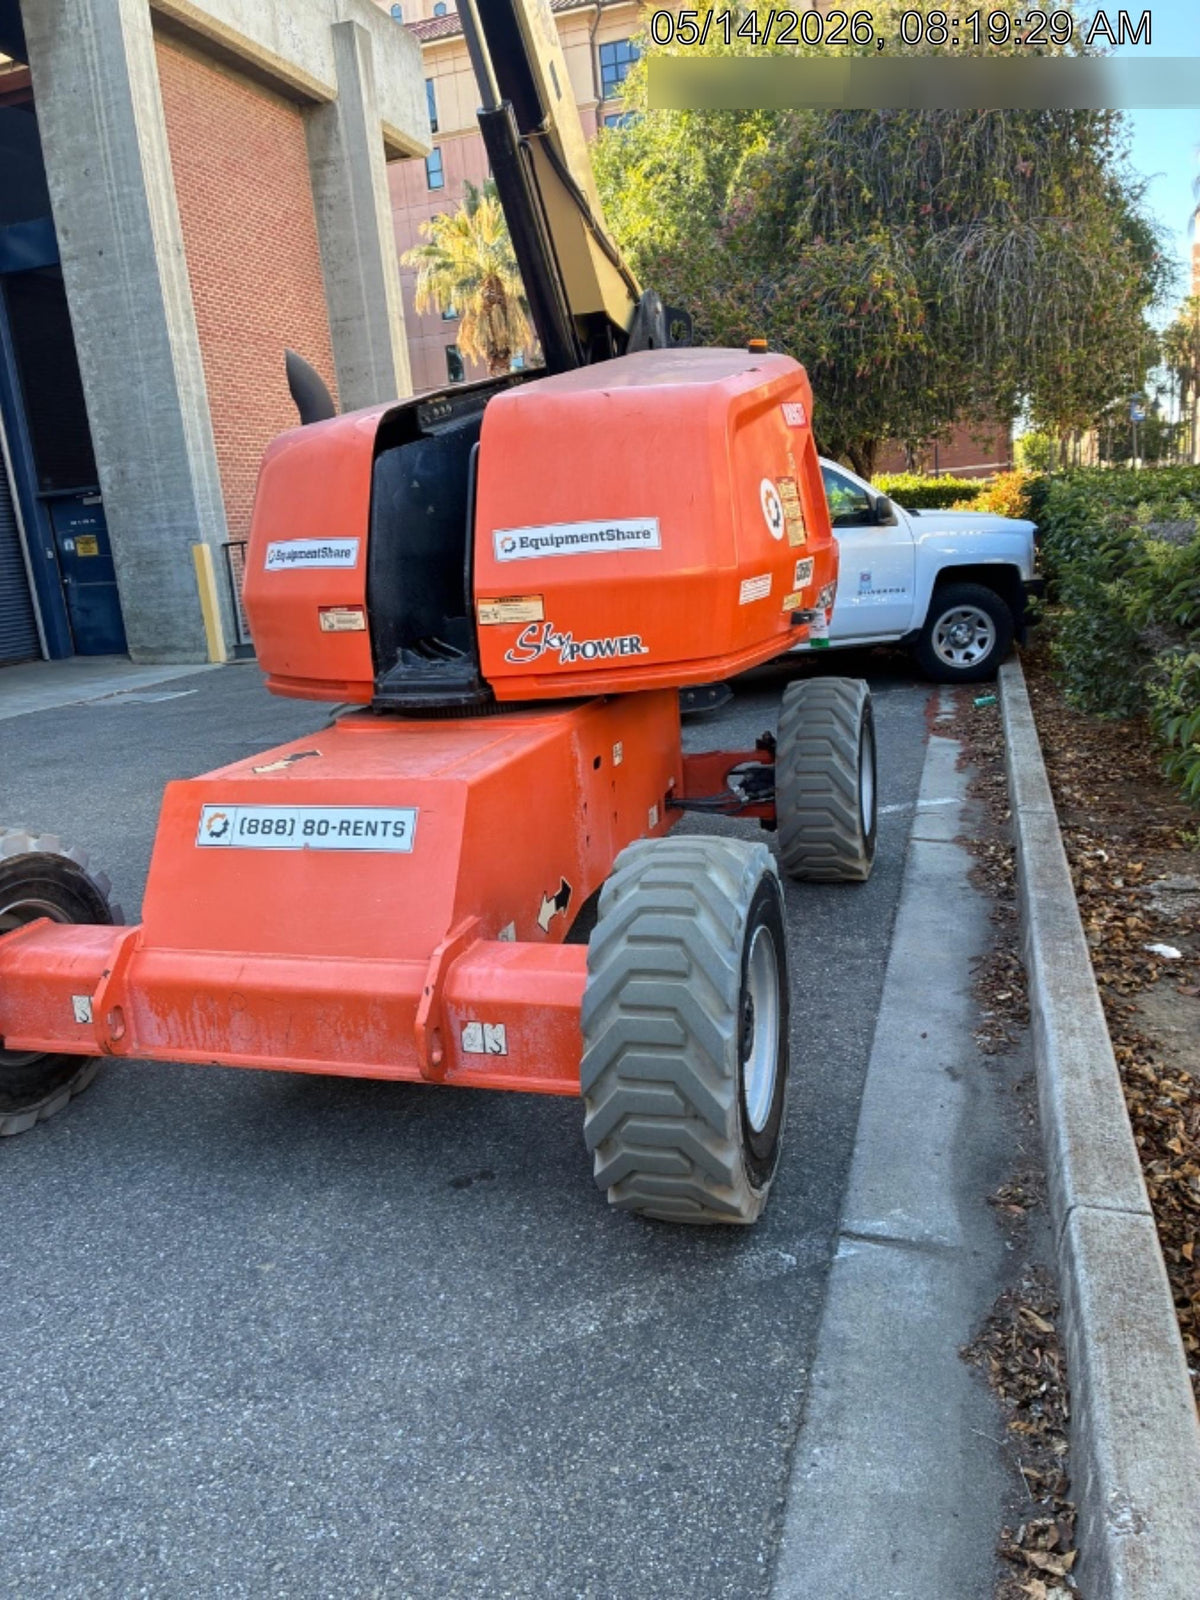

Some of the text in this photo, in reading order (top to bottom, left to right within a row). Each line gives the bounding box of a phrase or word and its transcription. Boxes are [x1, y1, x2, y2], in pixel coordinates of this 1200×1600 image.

[519, 528, 651, 550] EquipmentShare
[239, 817, 406, 838] (888) 80-RENTS
